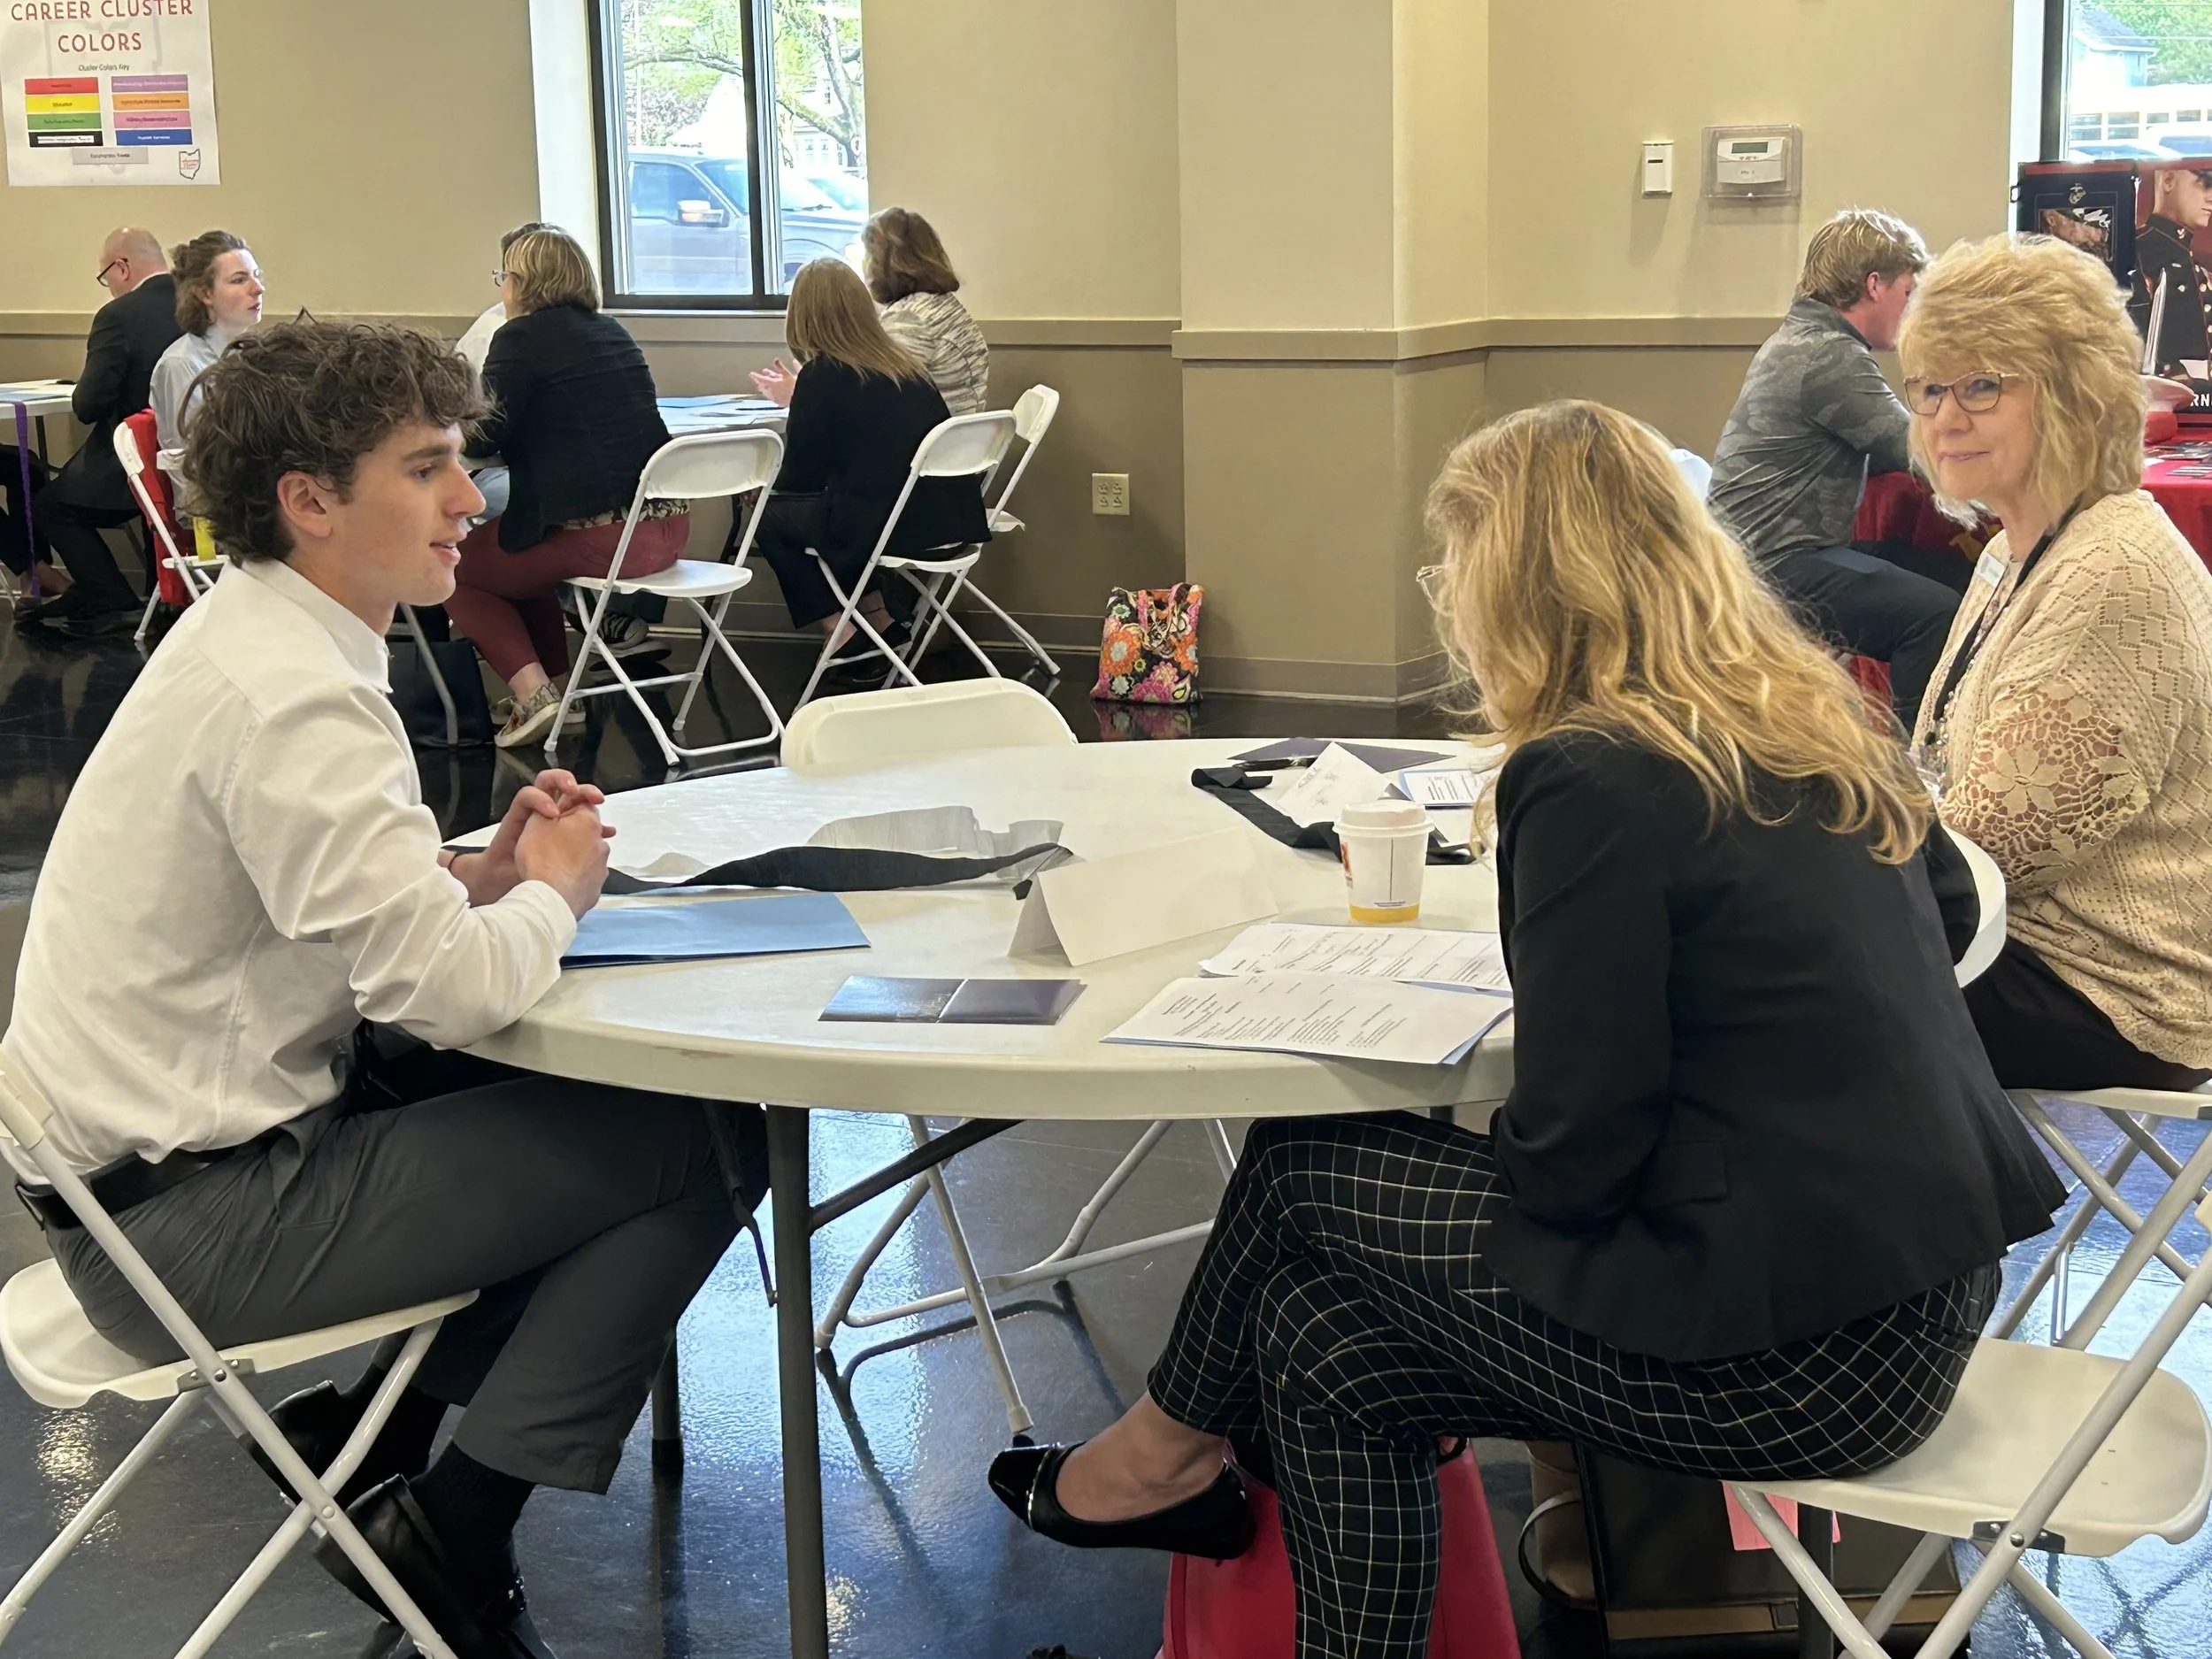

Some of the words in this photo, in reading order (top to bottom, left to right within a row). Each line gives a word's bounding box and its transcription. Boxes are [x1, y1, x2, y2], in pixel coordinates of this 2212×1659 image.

[12, 1, 91, 20] CAREER
[101, 0, 193, 18] CLUSTER
[58, 33, 142, 52] COLORS
[2190, 394, 2212, 407] RN
